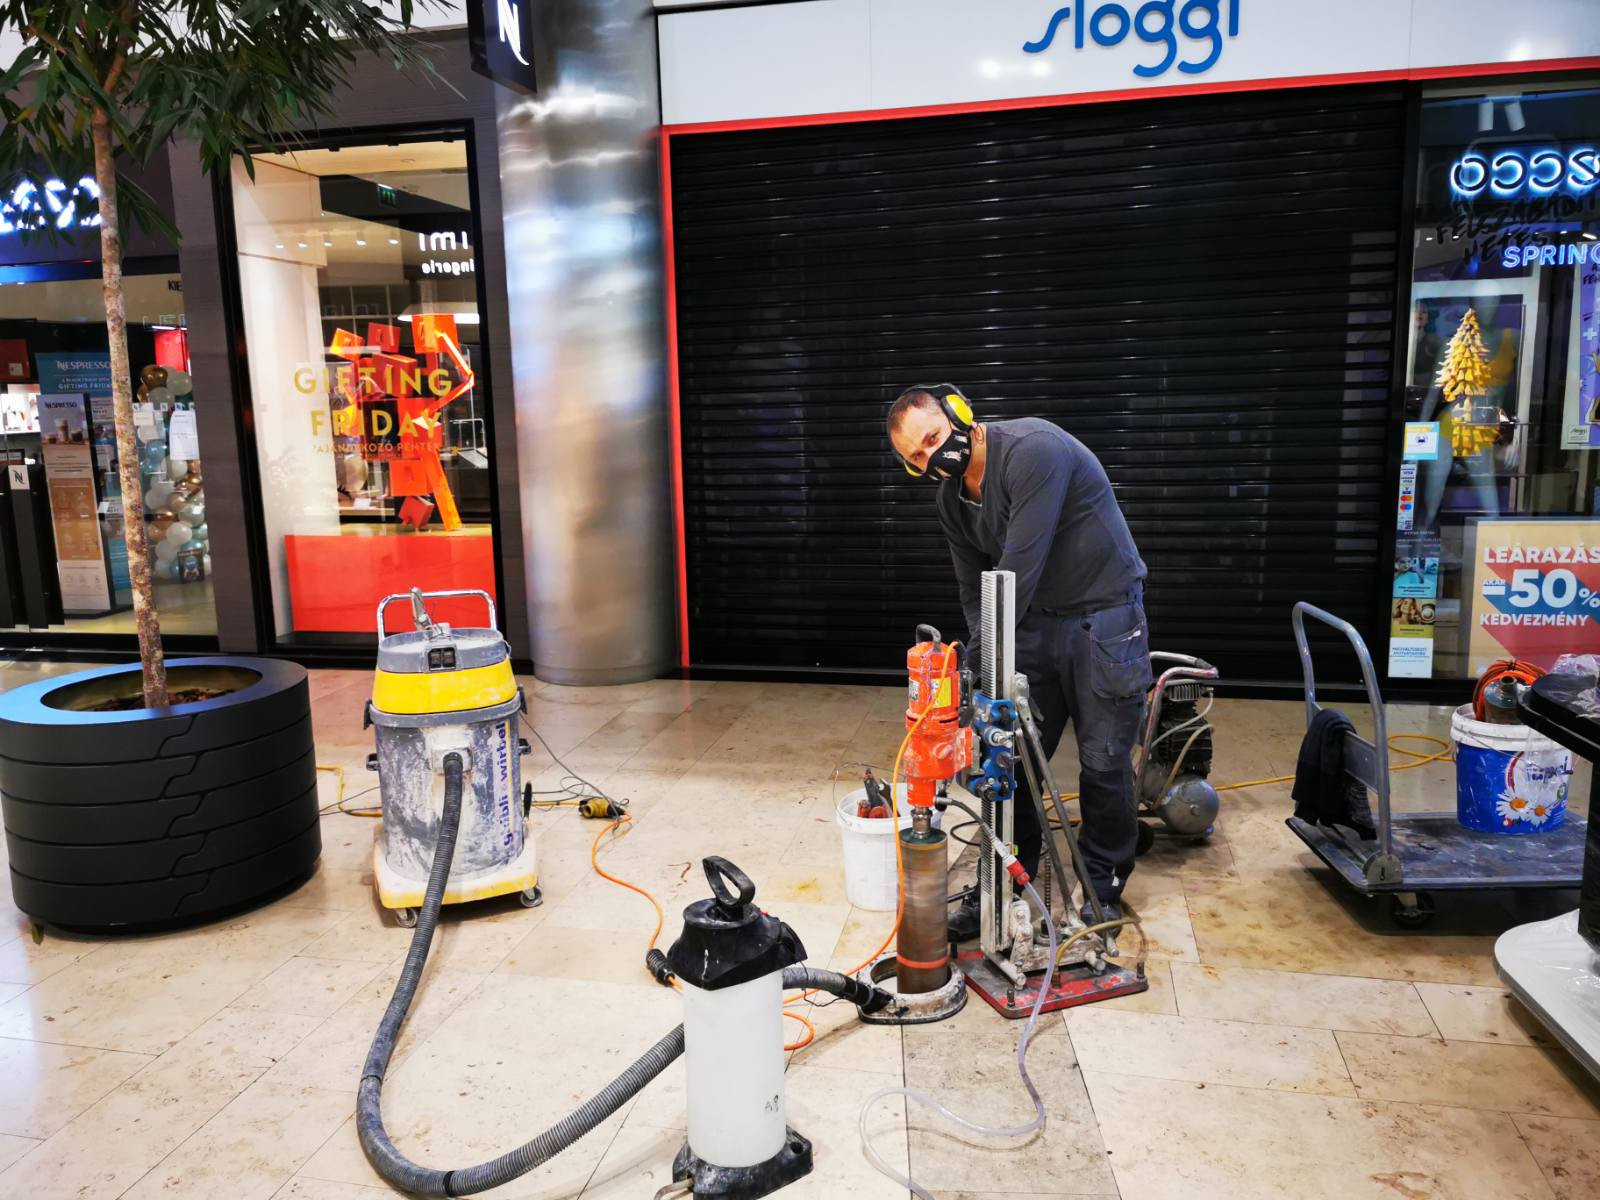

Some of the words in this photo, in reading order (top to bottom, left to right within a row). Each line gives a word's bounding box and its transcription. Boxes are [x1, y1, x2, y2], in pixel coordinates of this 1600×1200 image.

[1023, 0, 1239, 78] sloggi
[293, 366, 453, 397] GIFTING
[310, 408, 442, 438] FRIDAY
[1483, 543, 1600, 564] LEÁRAZÁS
[1480, 611, 1590, 626] KEDVEZMÉNY
